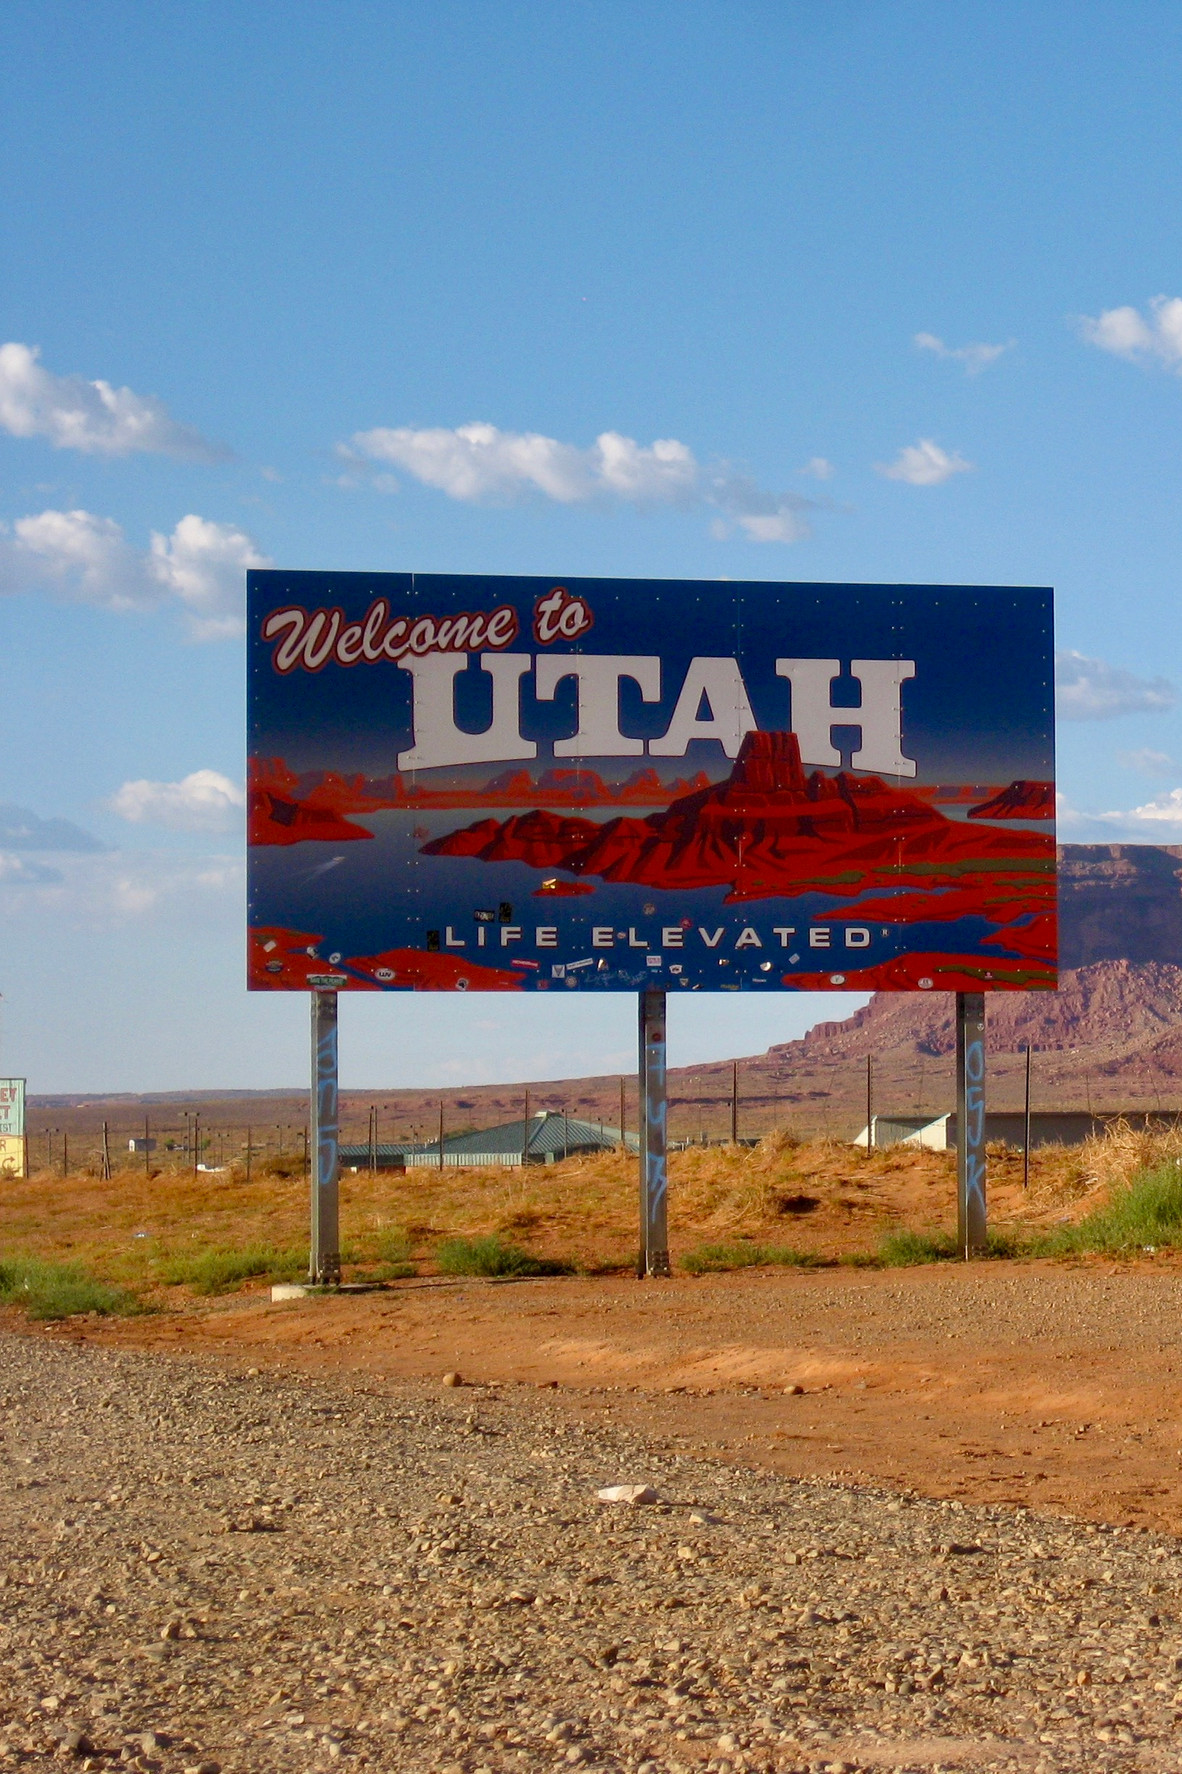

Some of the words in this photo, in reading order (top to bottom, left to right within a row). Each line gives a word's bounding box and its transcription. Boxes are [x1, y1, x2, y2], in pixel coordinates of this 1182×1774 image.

[264, 599, 516, 673] Welcome
[536, 589, 591, 641] to
[397, 652, 917, 778] UTAH
[445, 926, 558, 948] LIFE
[592, 927, 871, 948] ELEVATED
